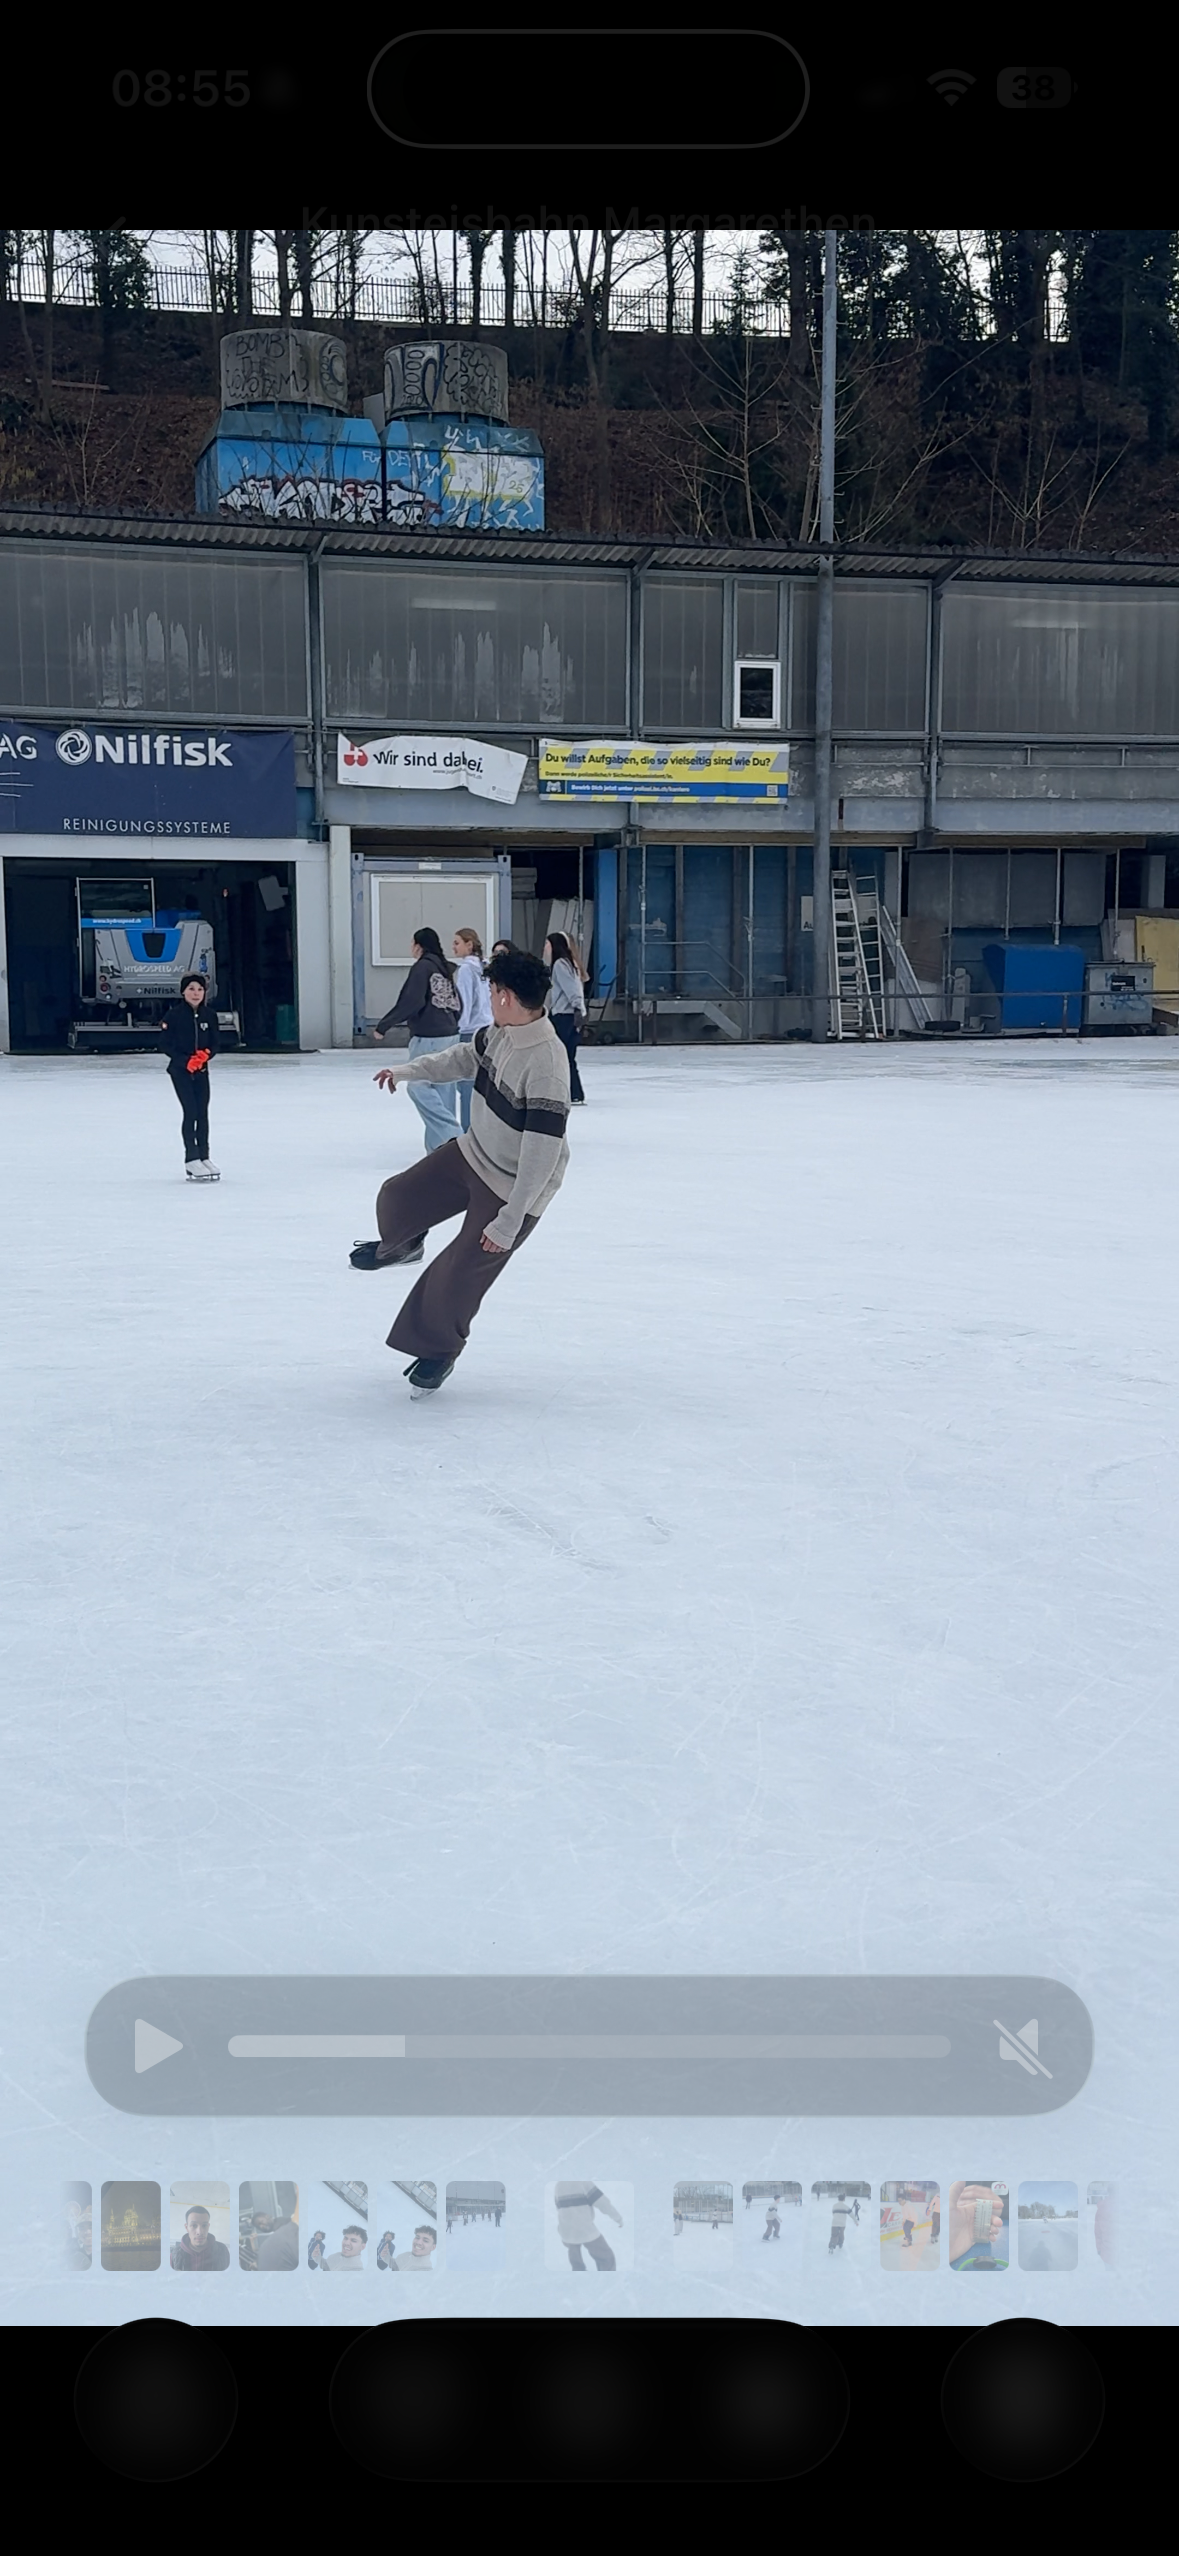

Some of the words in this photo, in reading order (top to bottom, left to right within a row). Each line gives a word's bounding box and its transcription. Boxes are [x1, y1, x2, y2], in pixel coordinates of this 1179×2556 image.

[236, 332, 285, 358] BOMB
[95, 735, 233, 767] Nilfisk
[373, 750, 399, 765] Wir
[404, 751, 437, 767] sind
[545, 753, 558, 762] Du
[561, 754, 586, 763] willst
[588, 754, 639, 766] Aufgaben,
[640, 755, 655, 765] die
[657, 757, 668, 765] so
[670, 755, 711, 767] vielseitig
[713, 756, 732, 765] sind
[734, 757, 751, 766] wie
[752, 757, 770, 766] Du?
[63, 818, 231, 834] REINIGUNGSSYSTEME
[144, 987, 176, 995] Nilfisk
